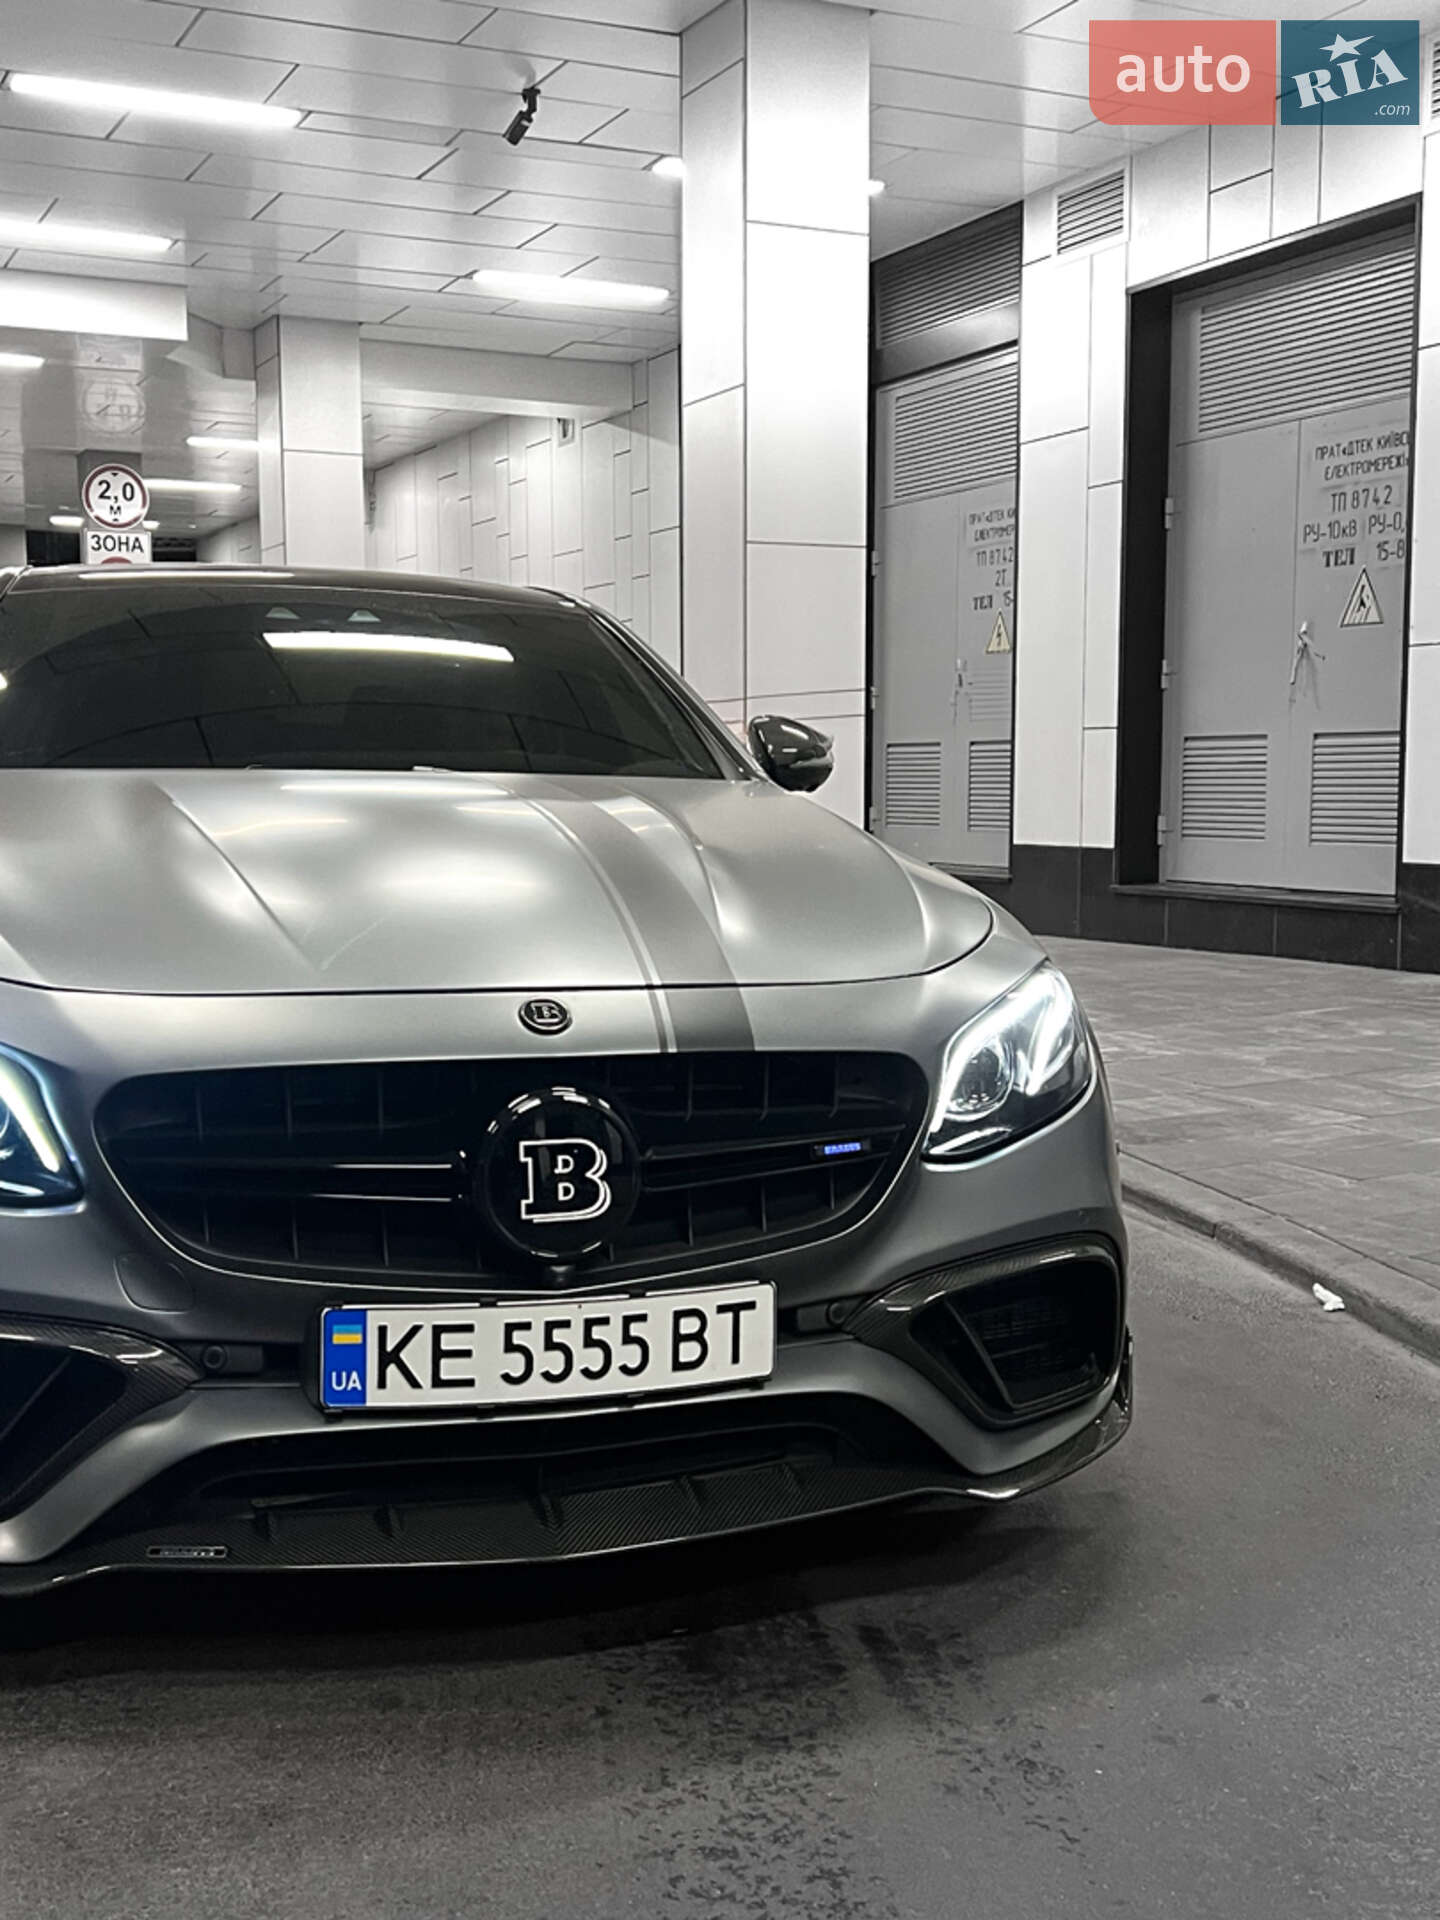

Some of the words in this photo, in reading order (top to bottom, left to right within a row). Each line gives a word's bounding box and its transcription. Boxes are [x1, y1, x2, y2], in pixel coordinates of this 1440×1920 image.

[98, 480, 135, 503] 2,0
[1331, 492, 1347, 512] ТП
[1351, 484, 1392, 509] 8742
[91, 534, 144, 553] ЗОНА
[1322, 547, 1355, 567] ТЕЛ
[519, 1138, 611, 1223] B
[377, 1324, 475, 1389] KE
[501, 1313, 649, 1385] 5555
[672, 1301, 757, 1372] BT
[332, 1372, 362, 1391] UA
